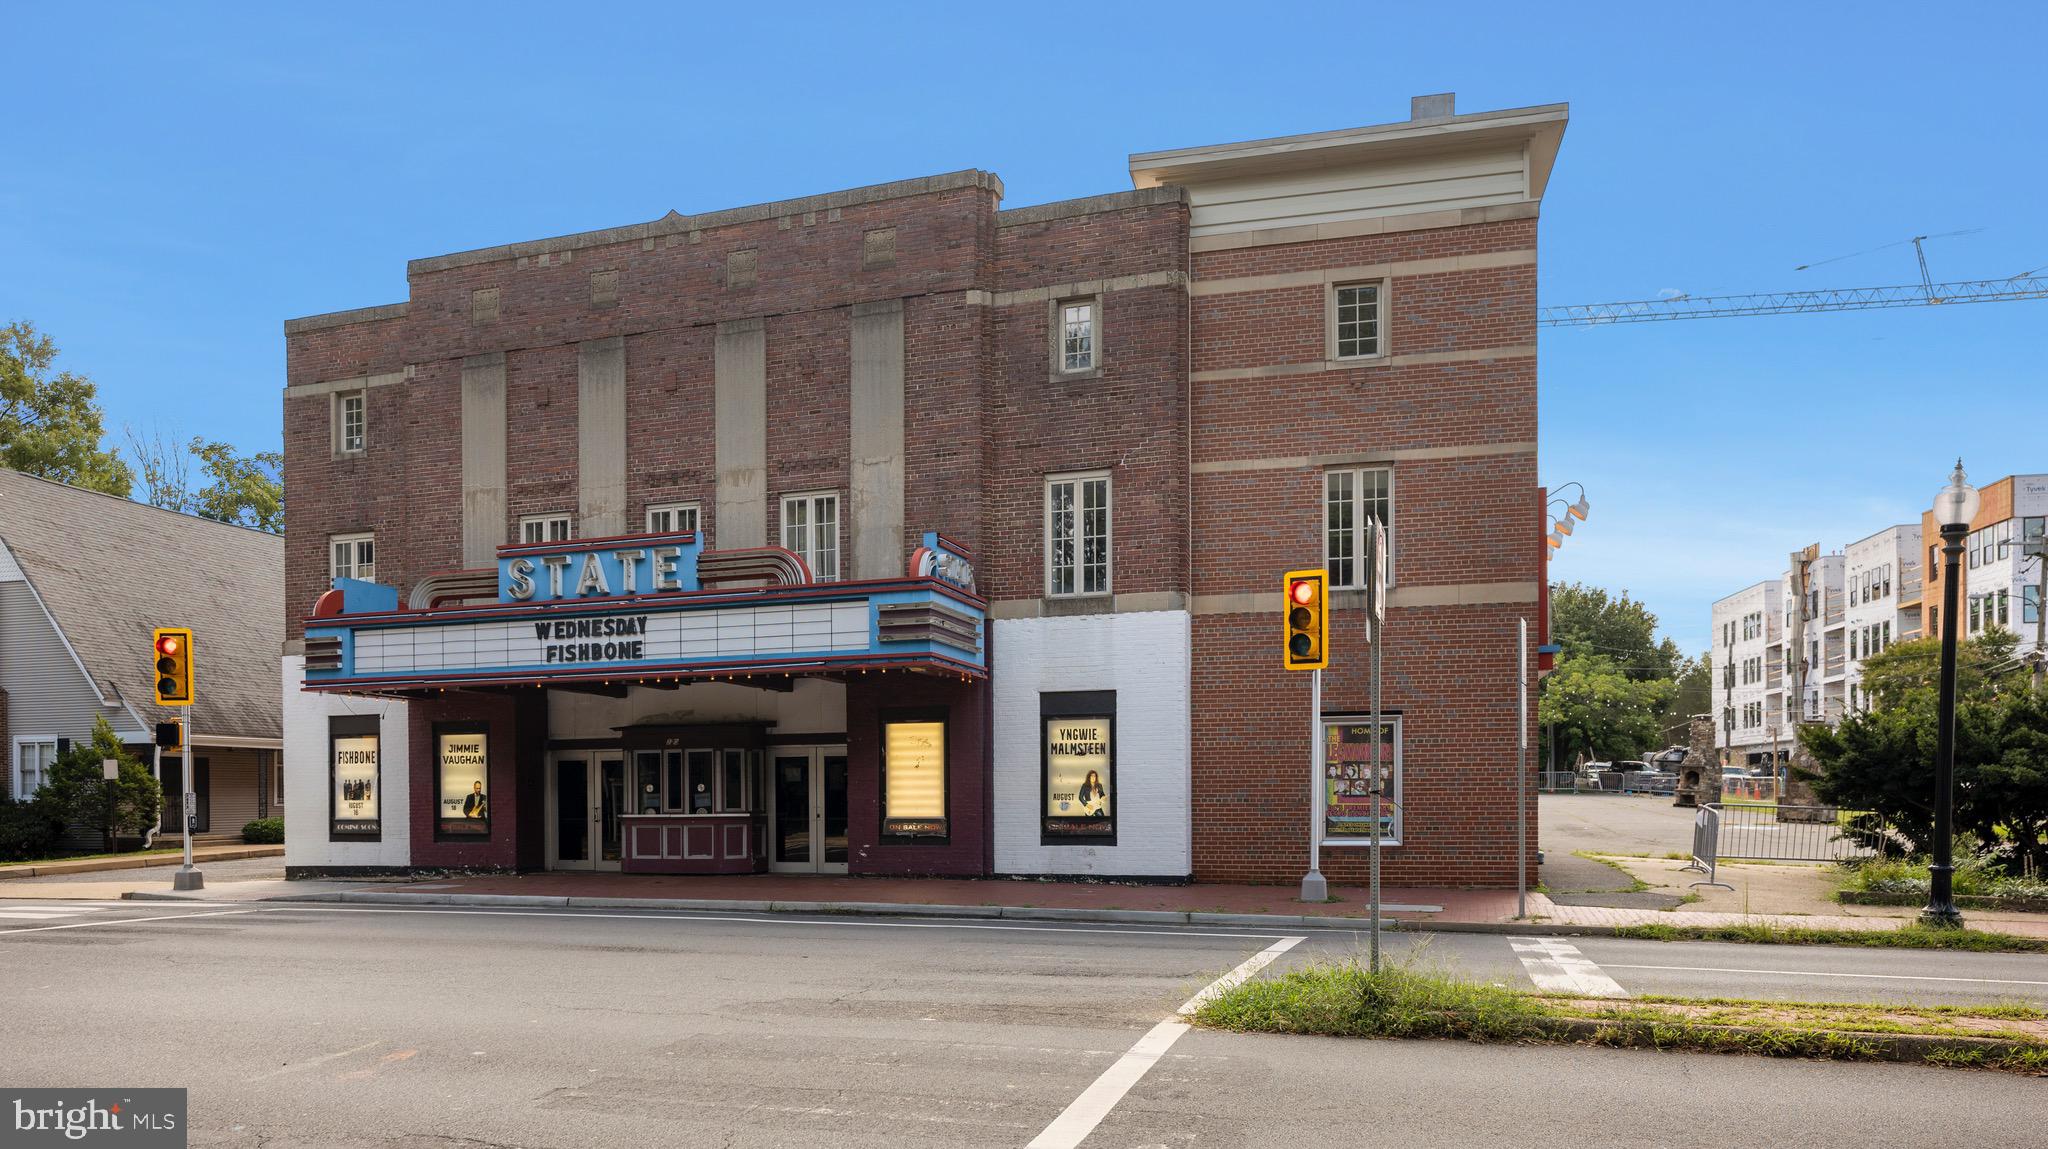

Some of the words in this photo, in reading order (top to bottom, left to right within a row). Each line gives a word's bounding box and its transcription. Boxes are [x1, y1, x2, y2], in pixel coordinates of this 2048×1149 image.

[507, 546, 682, 600] STATE
[535, 614, 648, 640] WEDNESDAY
[546, 640, 643, 663] FISHBONE
[1059, 728, 1097, 741] YNGWIE
[1351, 727, 1371, 735] HOM
[448, 744, 480, 753] JIMMIE
[1050, 742, 1106, 755] MALMSTEEN
[338, 750, 376, 764] FISHBONE
[443, 755, 485, 765] VAUGHAN
[1053, 793, 1075, 801] AUGUST
